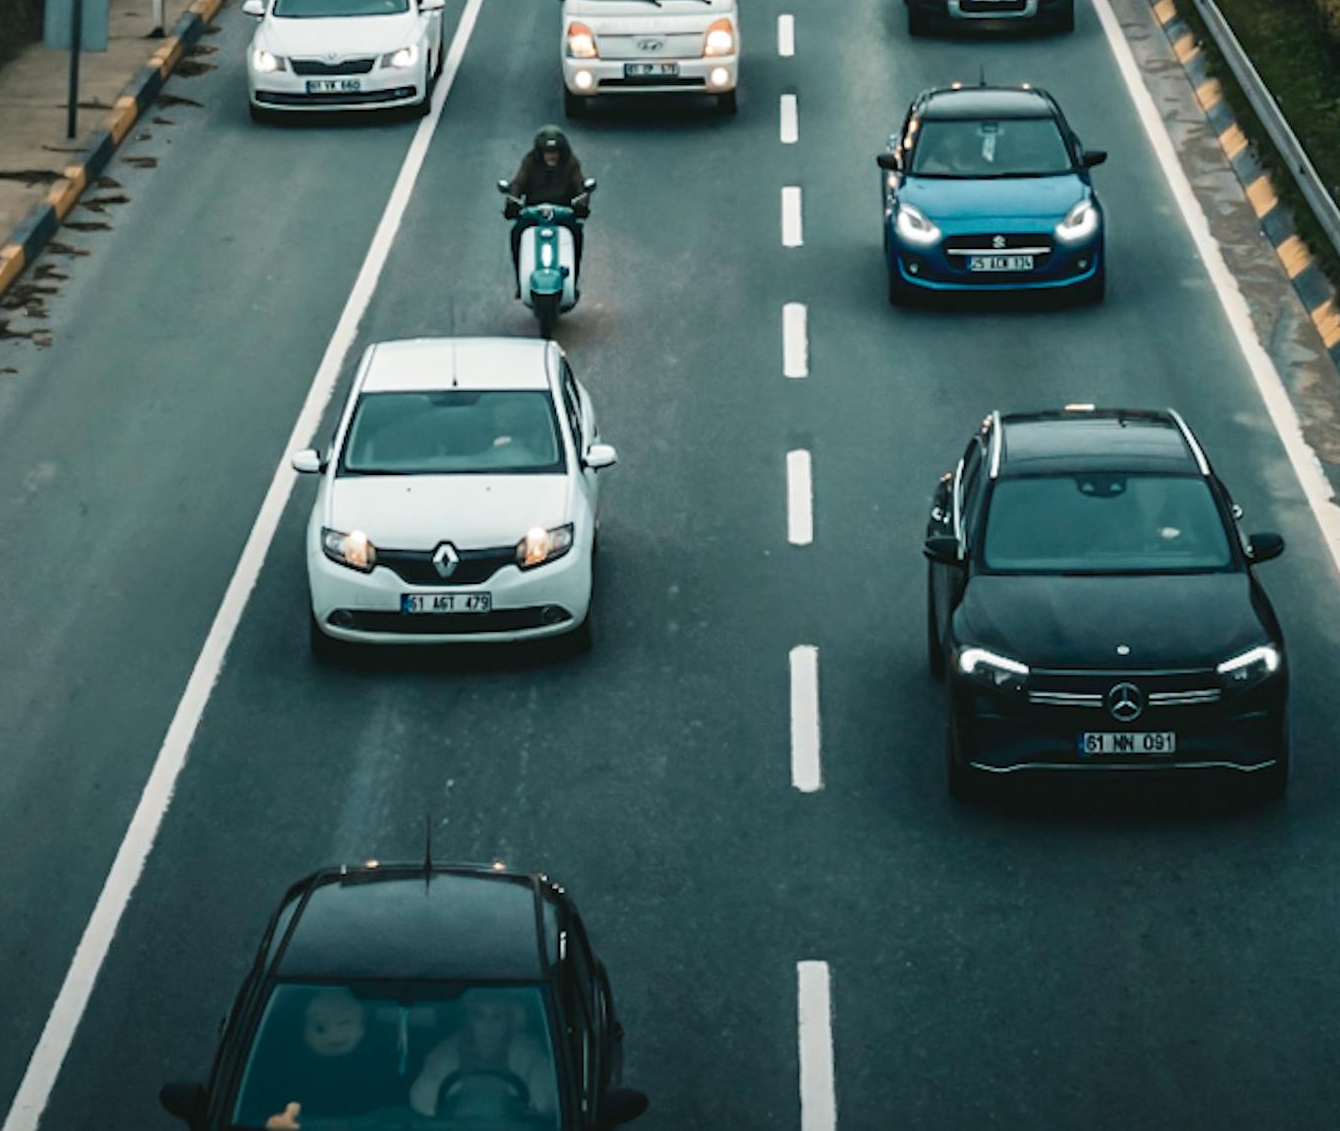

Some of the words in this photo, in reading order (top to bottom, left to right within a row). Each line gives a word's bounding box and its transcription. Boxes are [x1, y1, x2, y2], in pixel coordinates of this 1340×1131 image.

[410, 597, 424, 611] 61
[467, 597, 489, 610] 479
[1087, 735, 1103, 751] 61
[1143, 734, 1171, 750] 091
